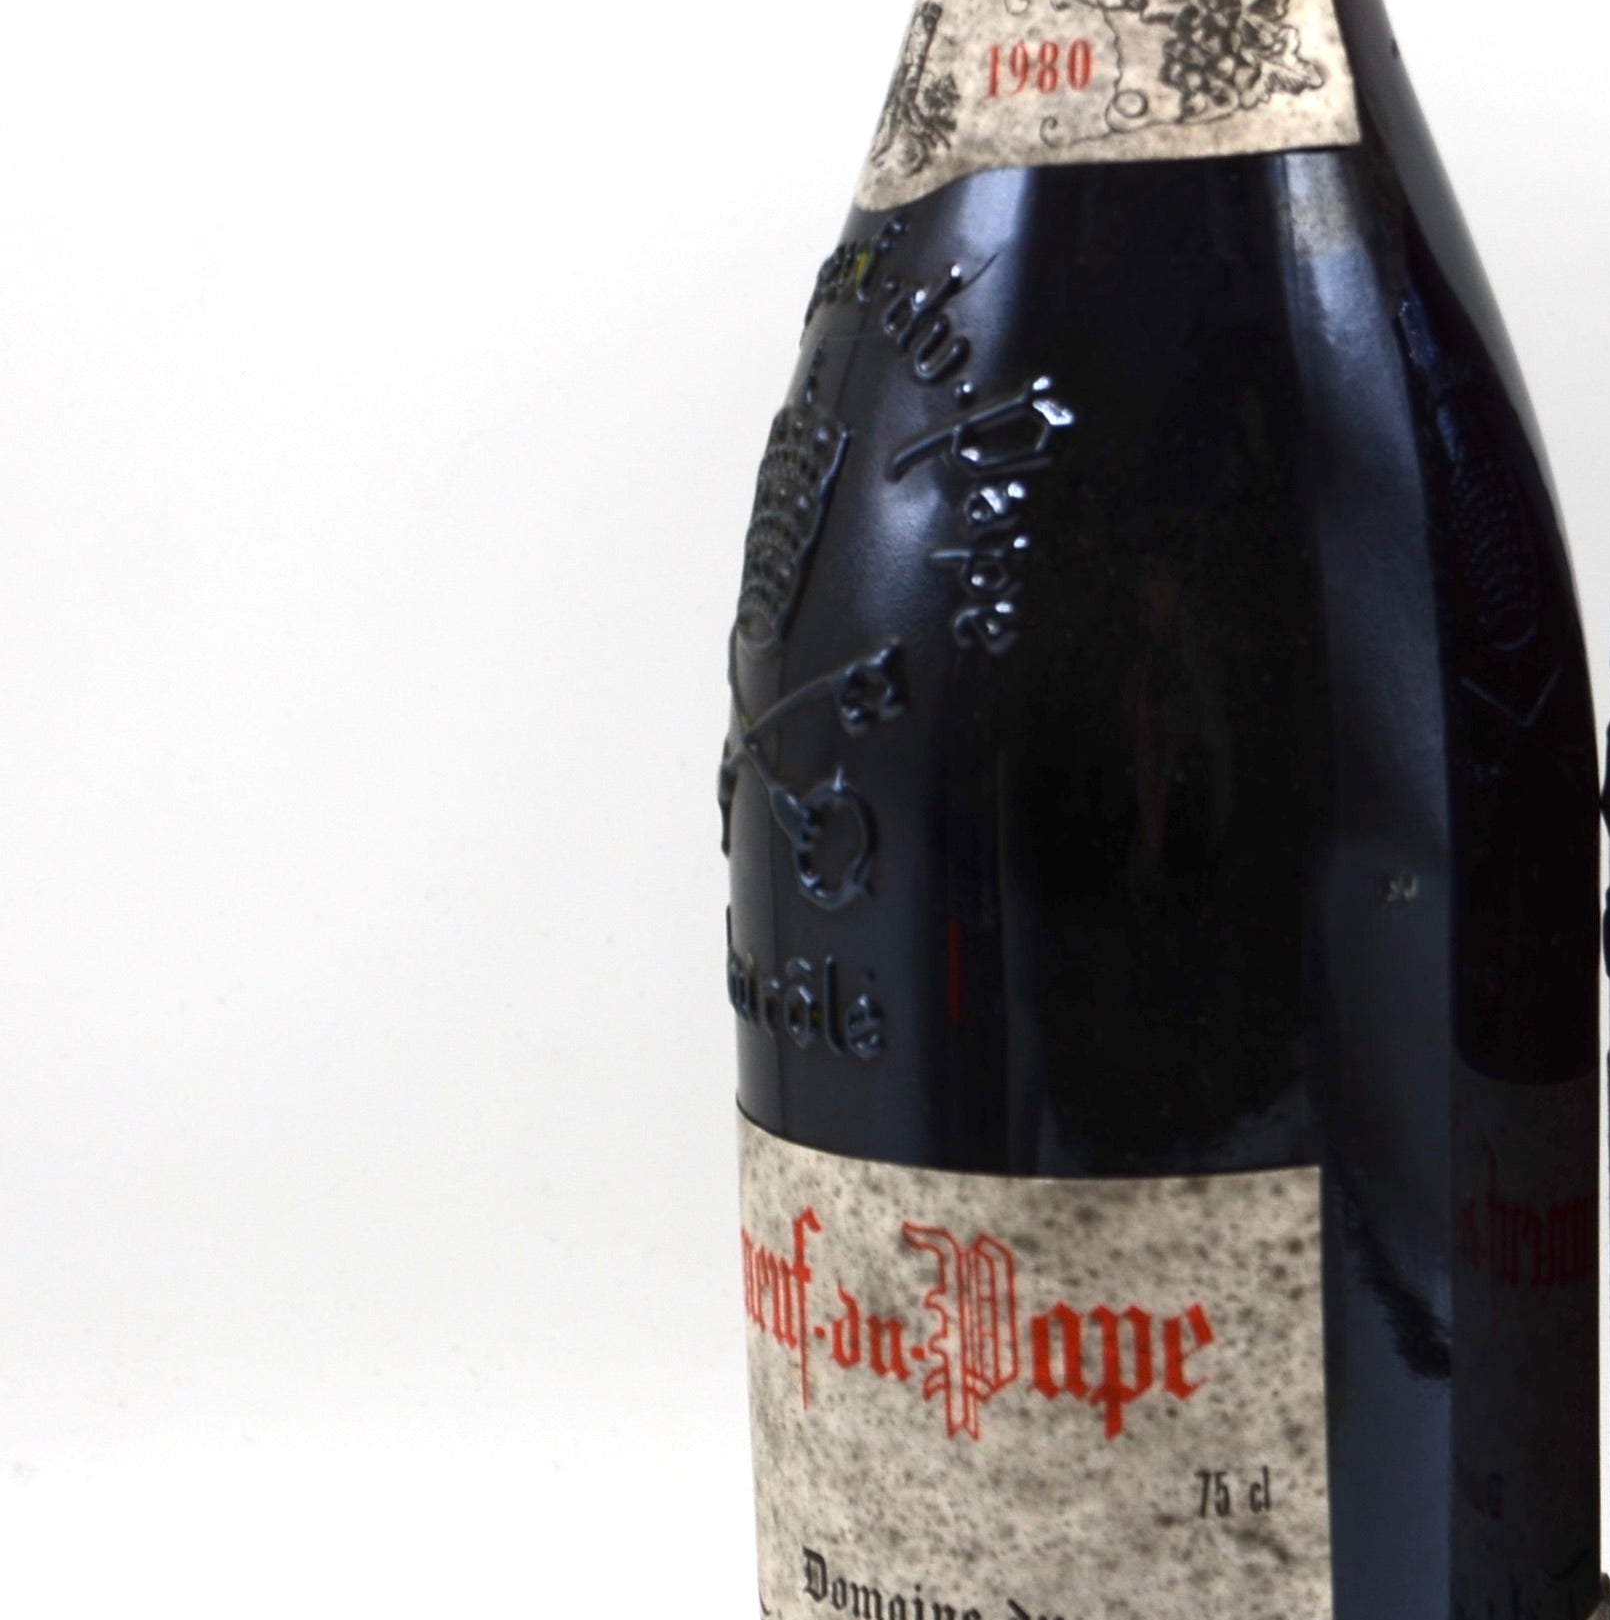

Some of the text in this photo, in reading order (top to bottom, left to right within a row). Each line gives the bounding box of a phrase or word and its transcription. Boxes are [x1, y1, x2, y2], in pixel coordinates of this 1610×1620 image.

[985, 38, 1093, 99] 1980
[1194, 1466, 1271, 1518] 75 cl
